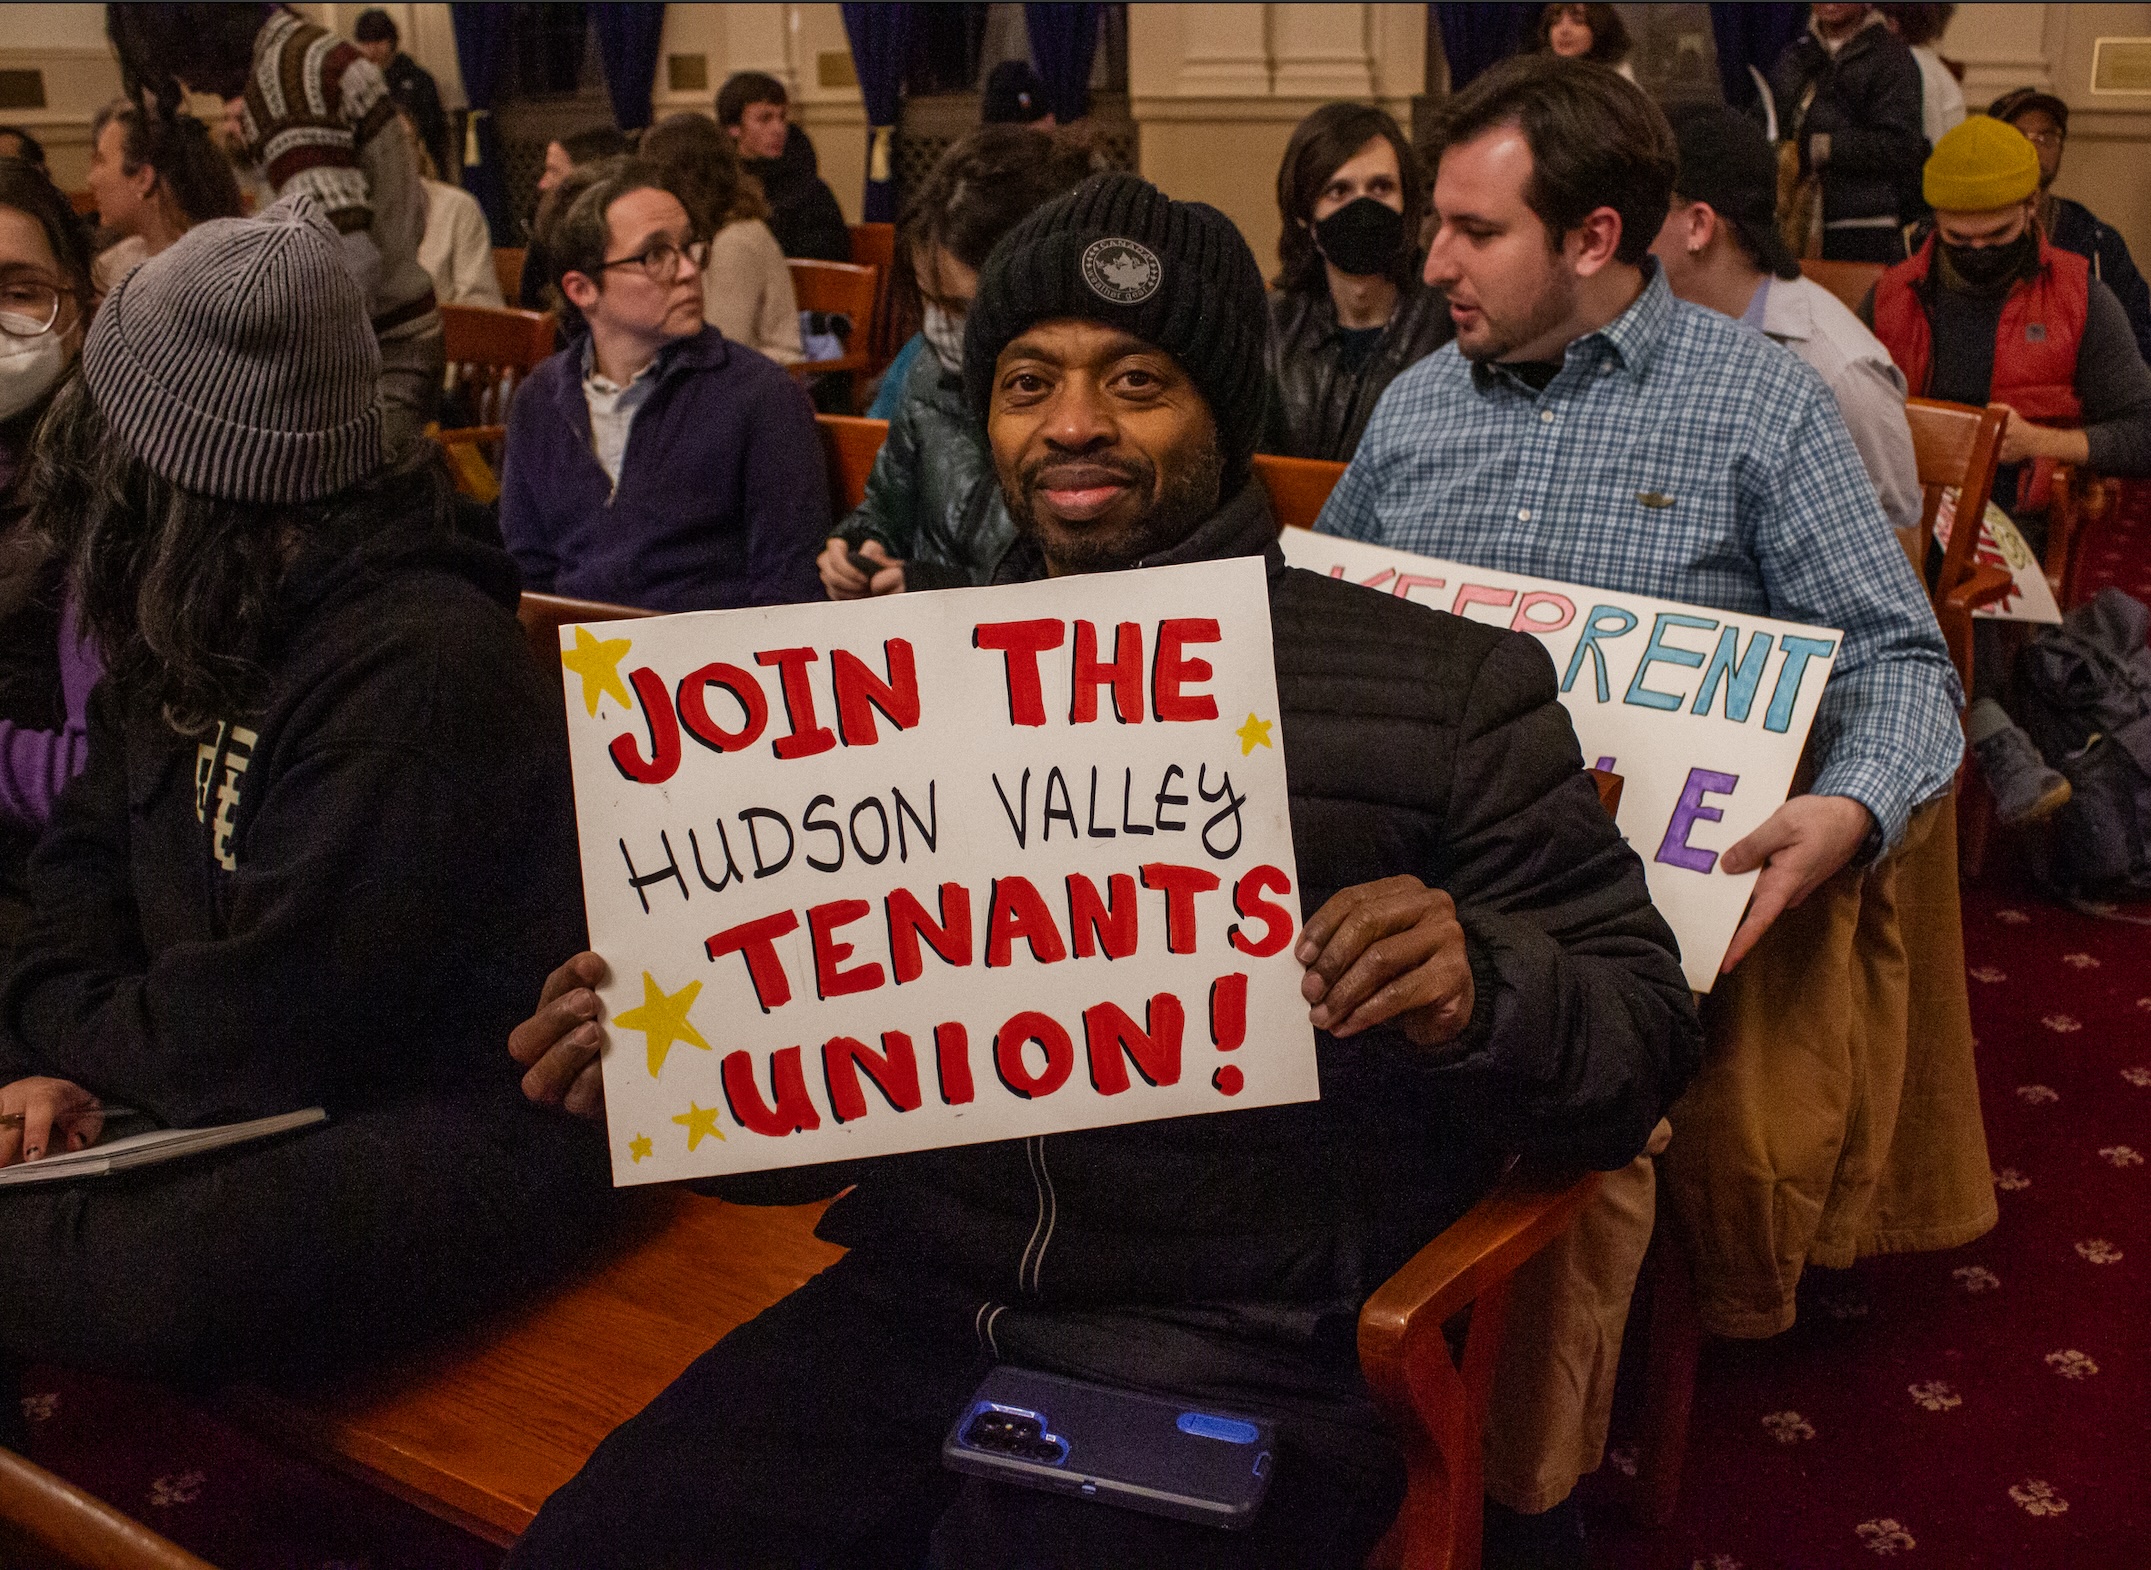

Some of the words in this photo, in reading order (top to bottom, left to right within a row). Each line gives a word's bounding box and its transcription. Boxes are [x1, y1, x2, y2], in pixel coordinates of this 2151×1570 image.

[1099, 240, 1150, 259] CANADA
[1125, 287, 1148, 301] gear
[609, 637, 921, 784] JOIN
[973, 618, 1221, 728] THE
[1560, 604, 1836, 734] RENT
[619, 780, 938, 914] HUDSON
[993, 763, 1246, 859] VALLEY
[706, 863, 1294, 1013] TENANTS
[720, 972, 1248, 1137] UNION!
